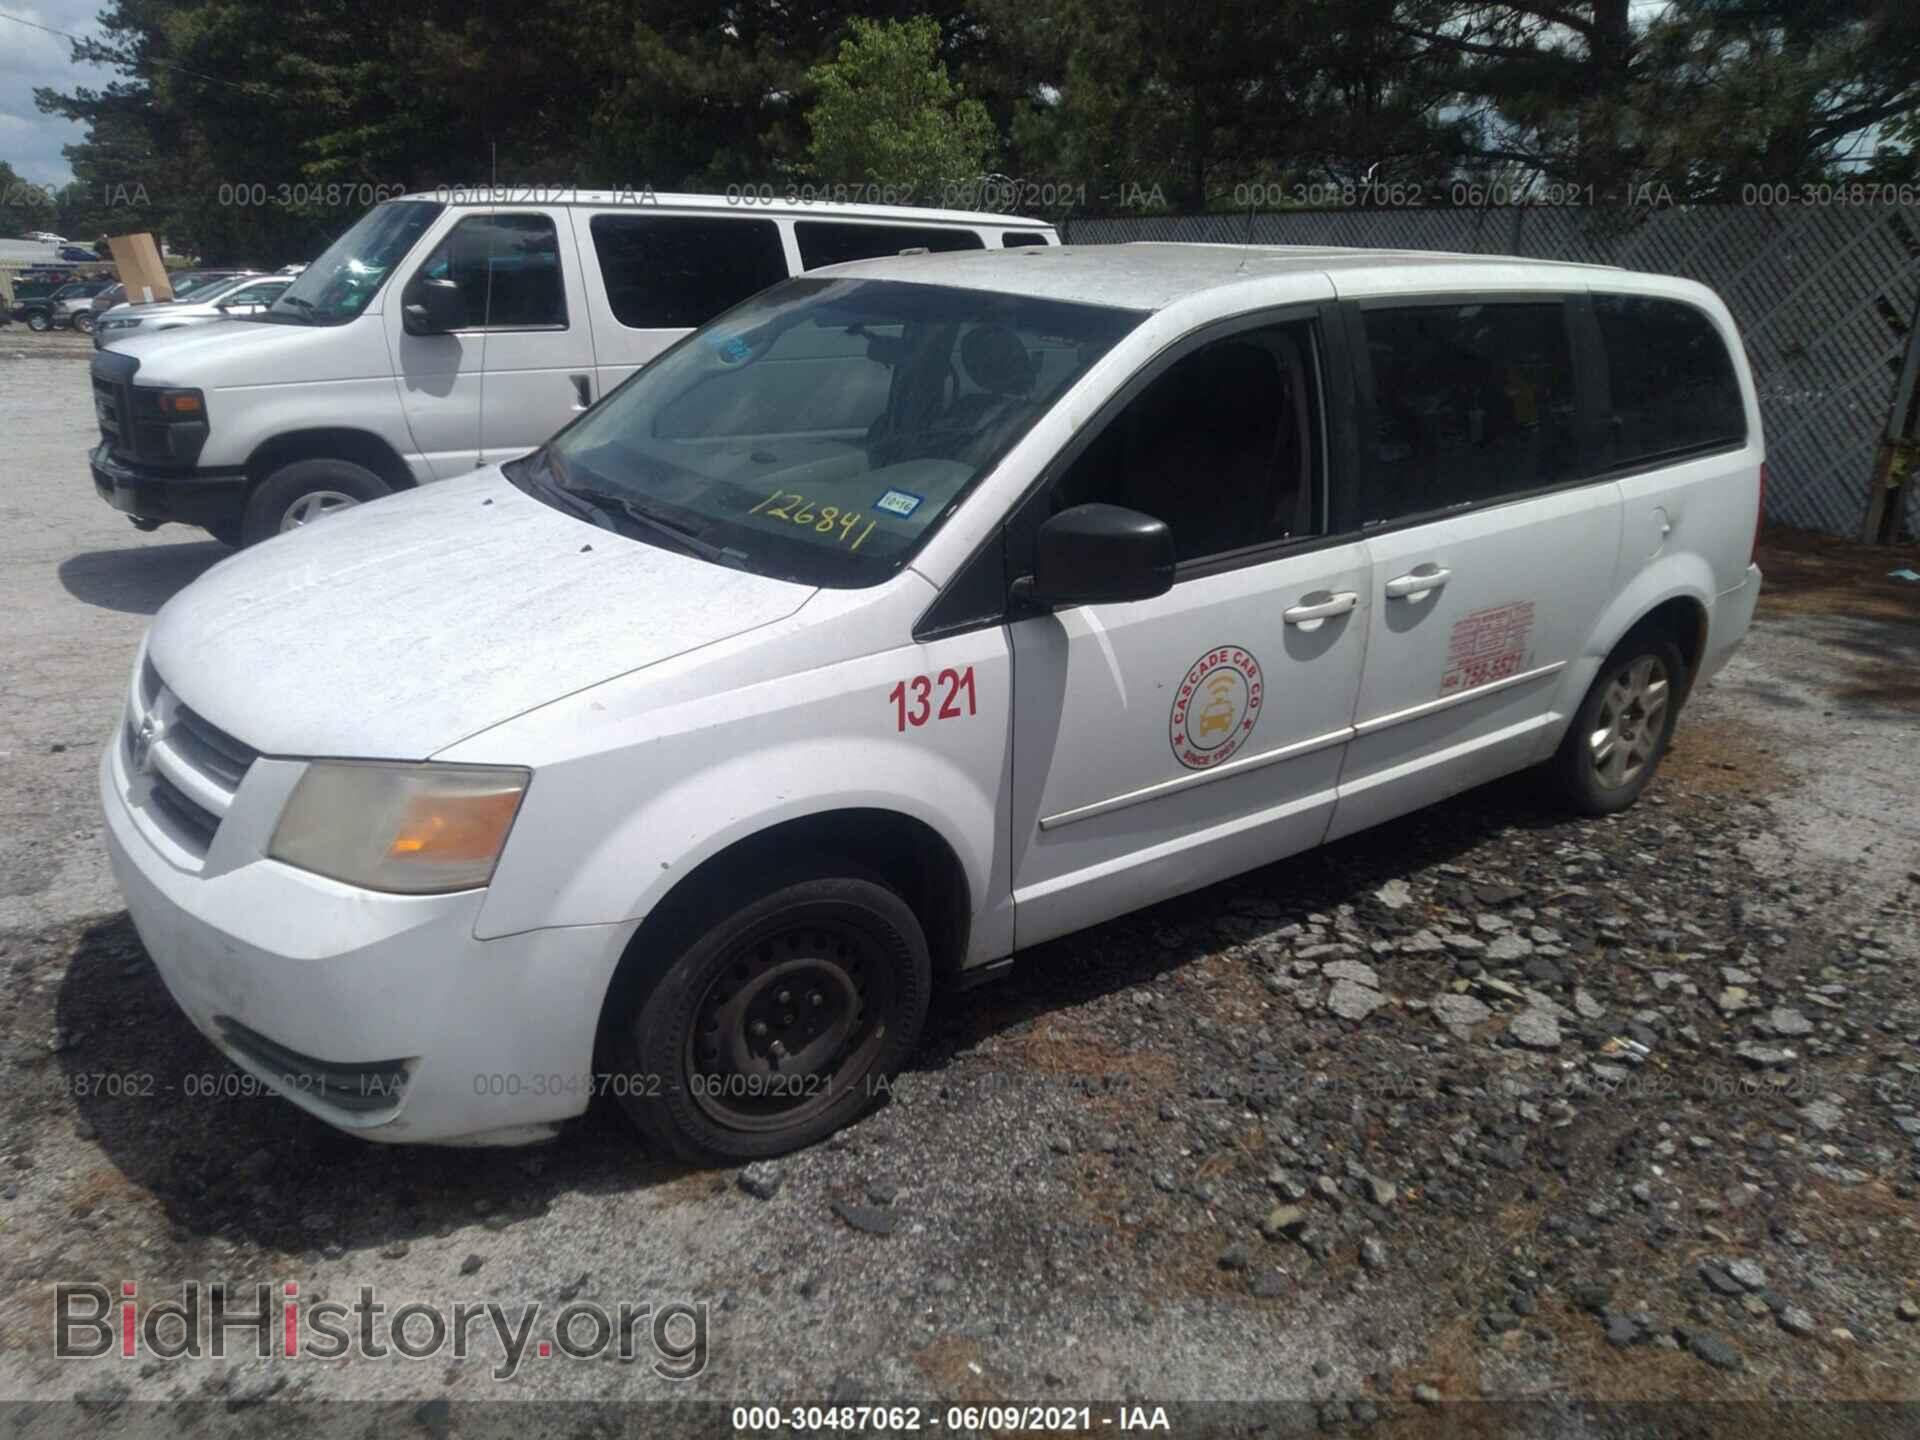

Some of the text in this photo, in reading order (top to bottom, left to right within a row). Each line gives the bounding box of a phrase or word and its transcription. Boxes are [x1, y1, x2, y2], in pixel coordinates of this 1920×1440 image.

[748, 489, 876, 550] 126841
[889, 666, 976, 732] 1321
[1174, 651, 1260, 724] CASCADE CAB CO
